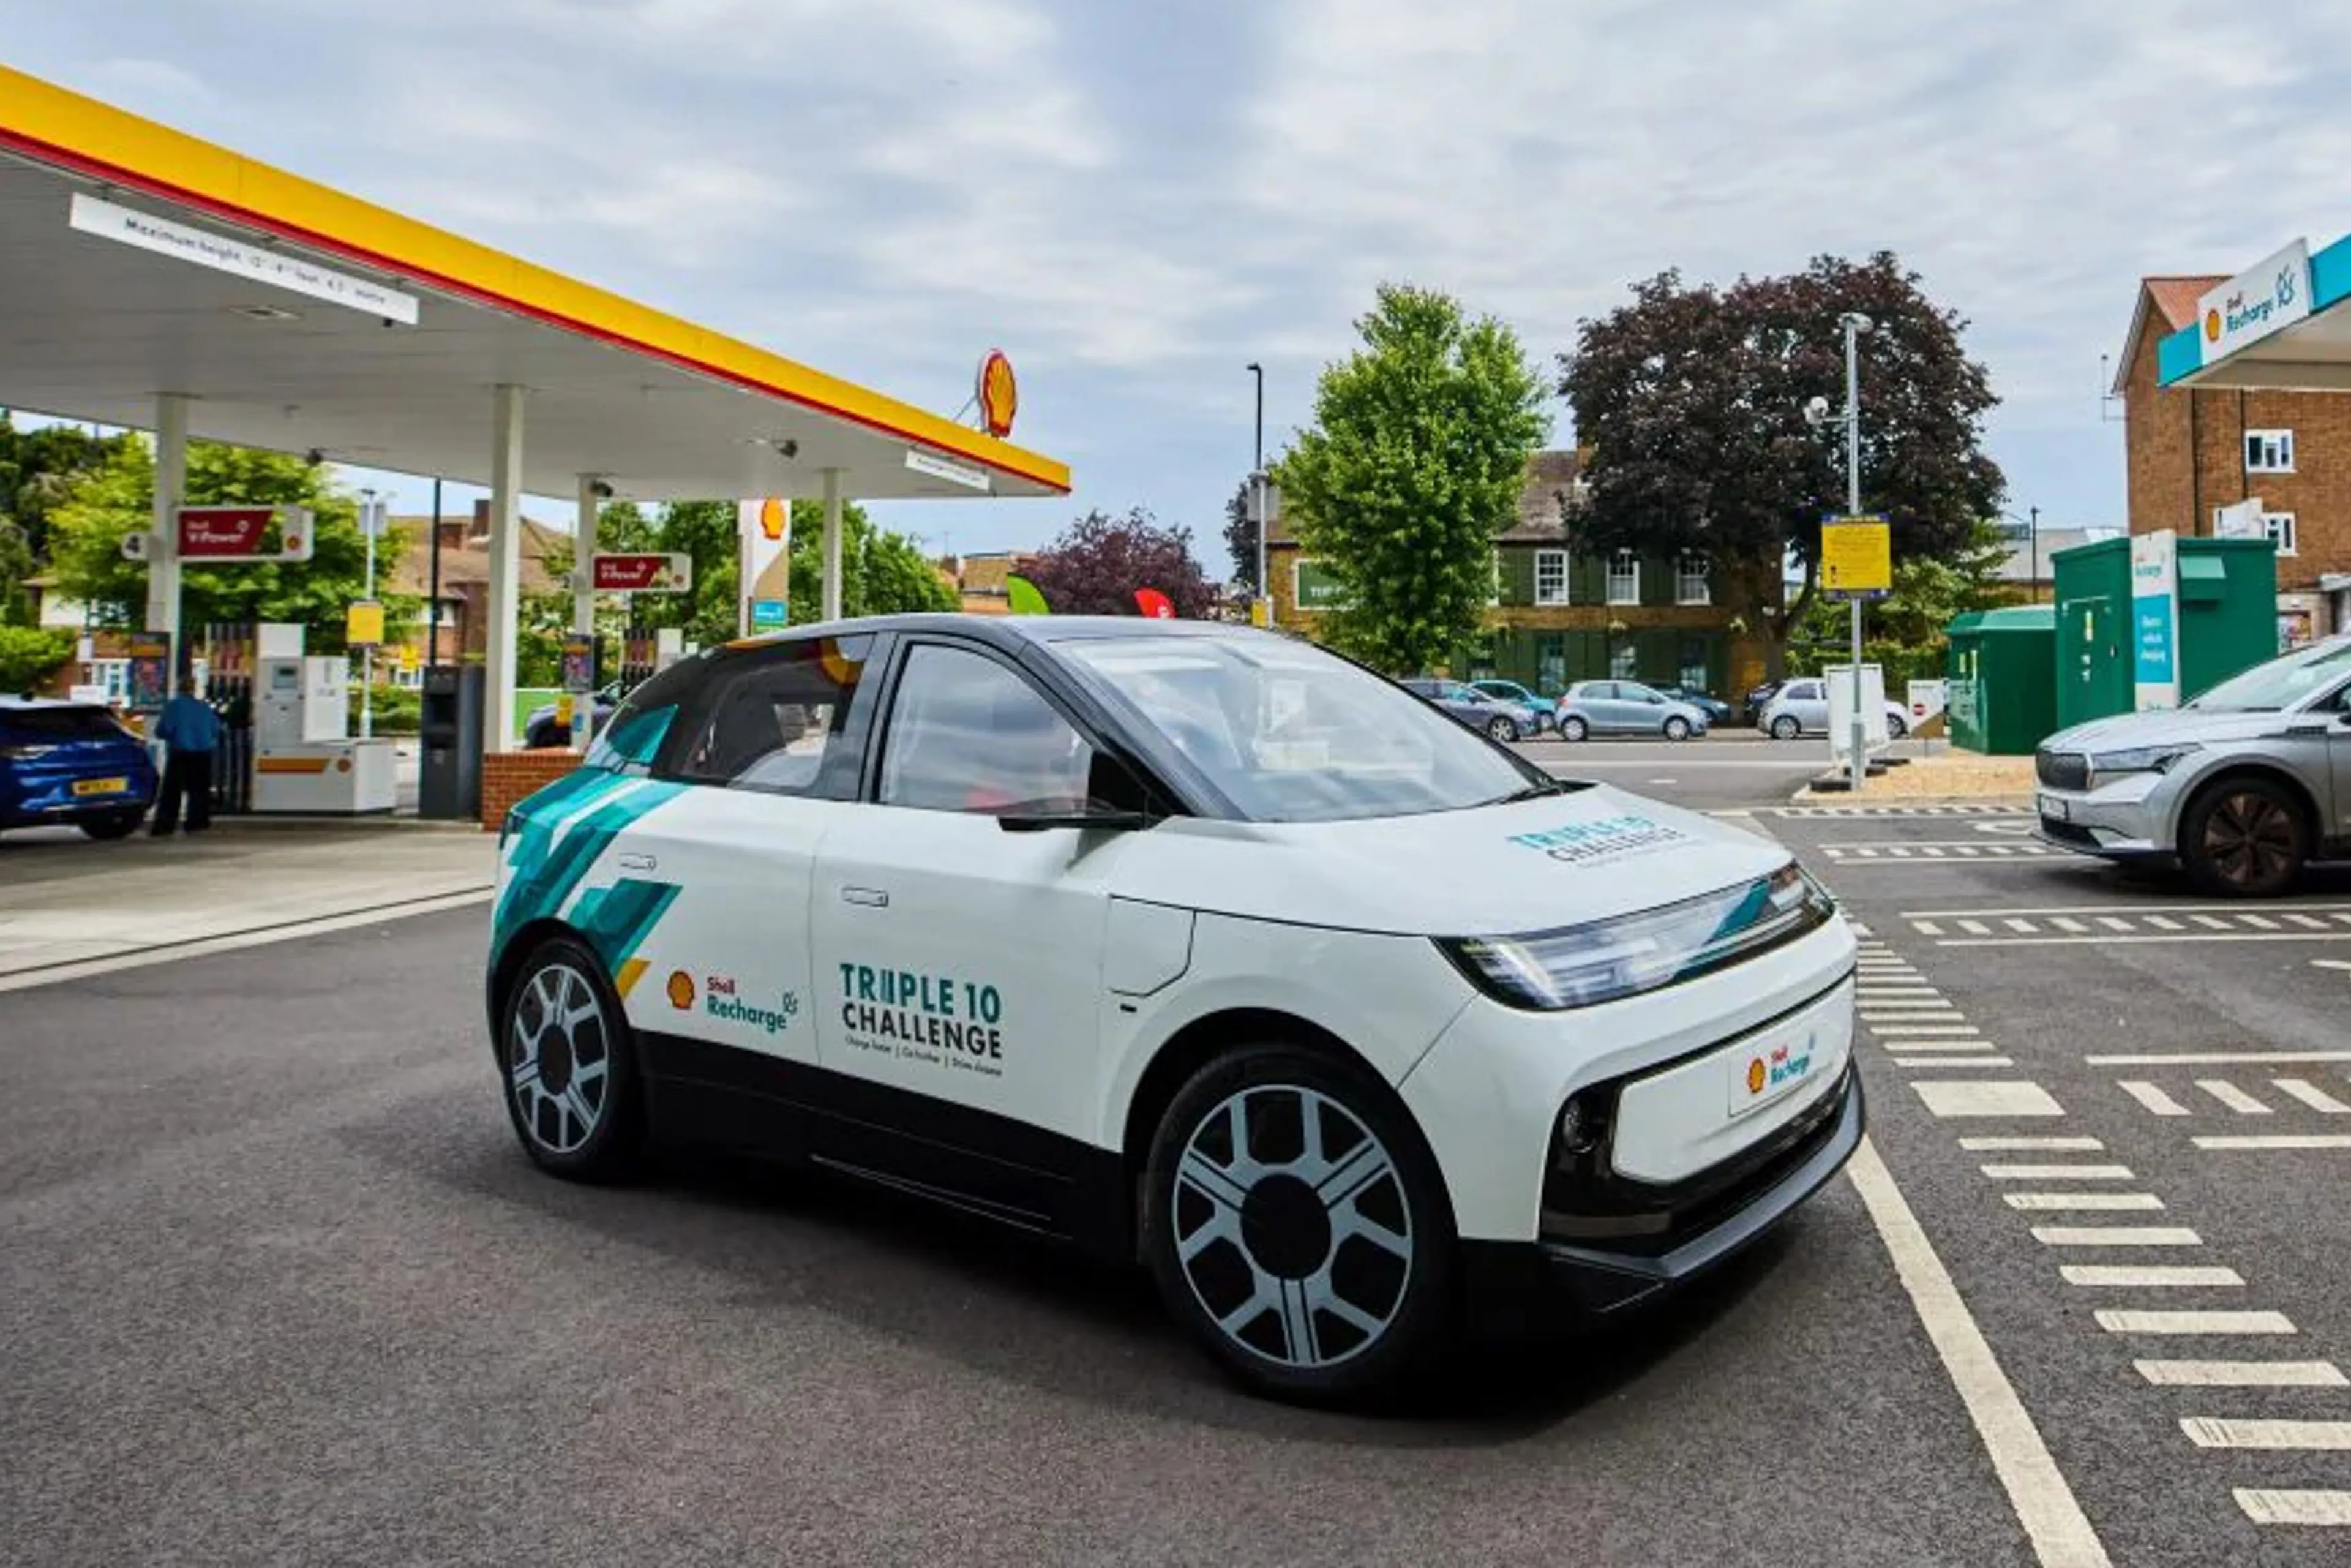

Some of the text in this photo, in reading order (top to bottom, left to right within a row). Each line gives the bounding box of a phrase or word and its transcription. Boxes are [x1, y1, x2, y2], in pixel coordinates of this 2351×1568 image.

[2226, 298, 2274, 332] Recharge
[707, 993, 787, 1033] Recharge
[964, 983, 1000, 1024] 10
[842, 1002, 1002, 1059] CHALLENGE
